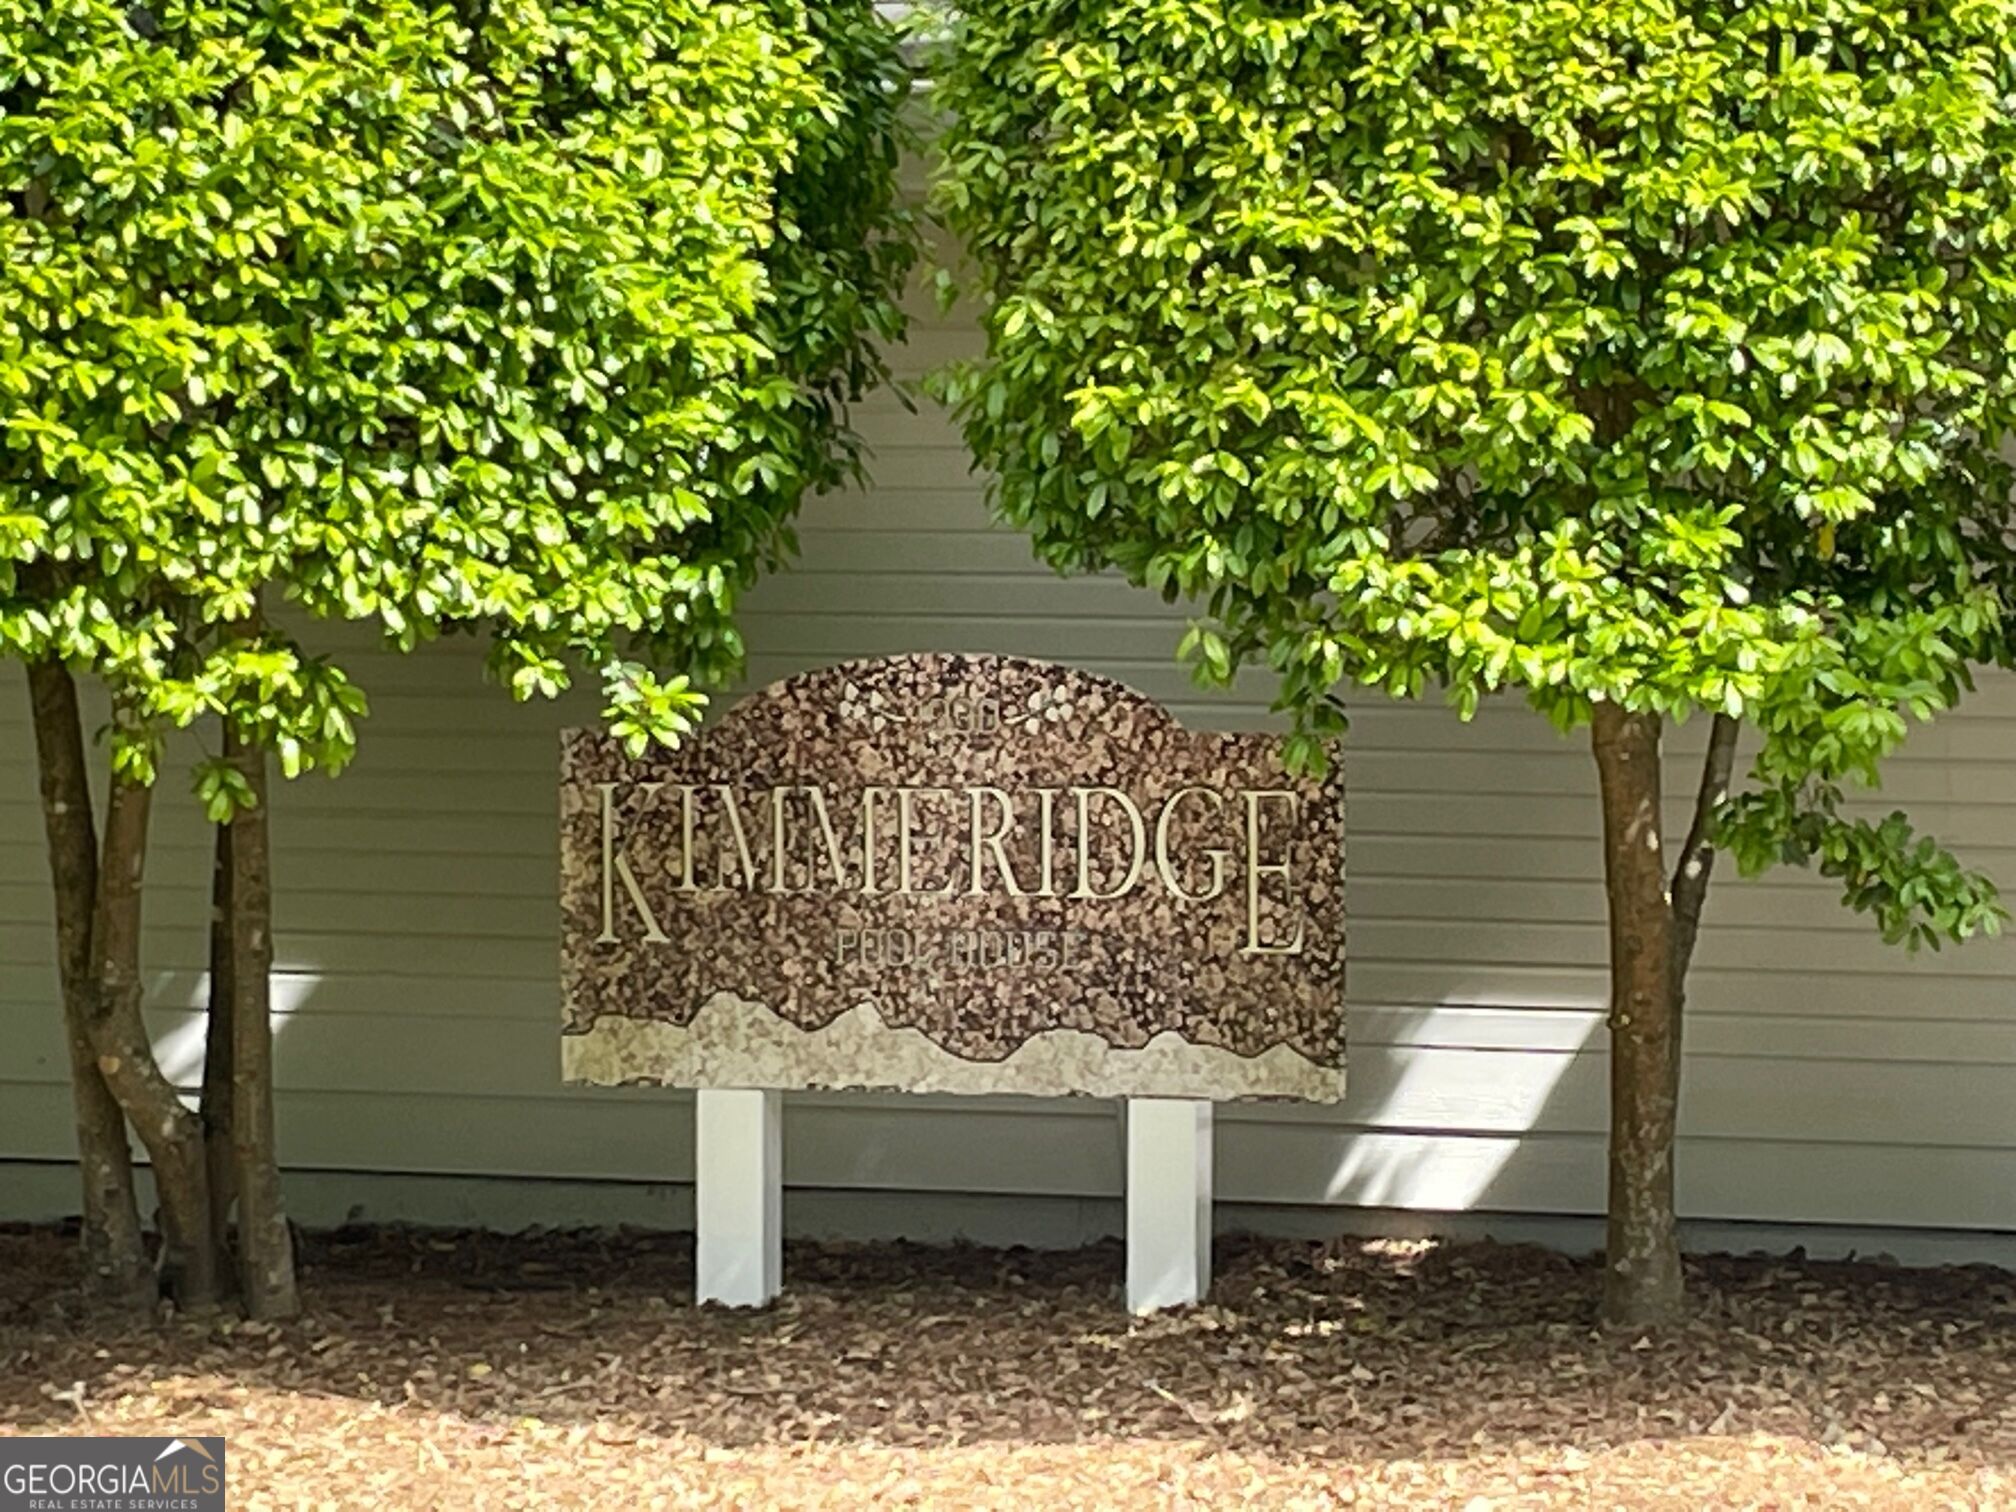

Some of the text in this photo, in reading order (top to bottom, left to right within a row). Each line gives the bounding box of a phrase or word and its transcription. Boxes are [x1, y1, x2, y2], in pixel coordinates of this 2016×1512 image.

[595, 782, 1303, 954] KIMMERIDGE
[835, 928, 1085, 969] POOL HOUSE
